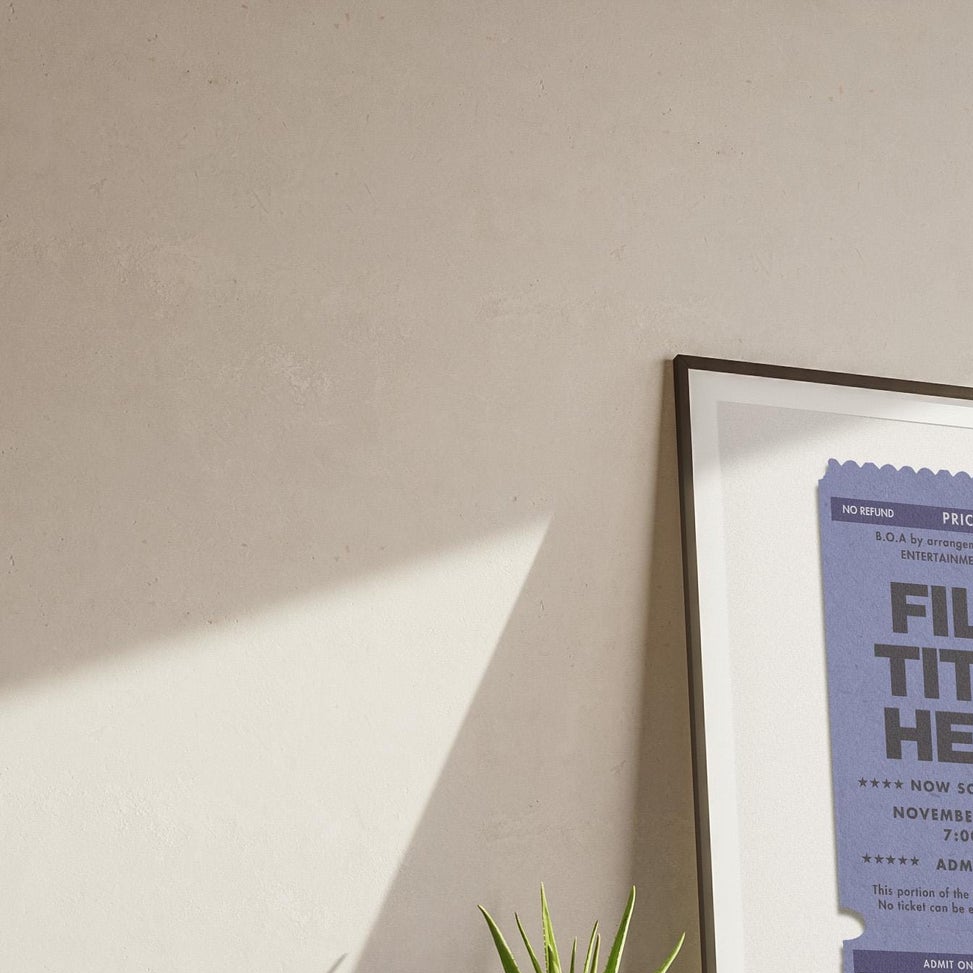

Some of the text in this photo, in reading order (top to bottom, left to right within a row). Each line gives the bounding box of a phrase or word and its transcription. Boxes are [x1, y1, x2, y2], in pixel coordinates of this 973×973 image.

[842, 505, 894, 518] NO REFUND
[875, 531, 906, 543] B.O.A
[910, 533, 923, 547] by
[910, 779, 950, 793] NOW
[872, 884, 893, 896] This
[897, 887, 935, 898] portion
[939, 887, 949, 898] of
[953, 888, 969, 899] the
[878, 899, 894, 911] No
[897, 900, 926, 912] ticket
[930, 904, 948, 913] can
[952, 902, 965, 914] be
[923, 959, 954, 970] ADMIT
